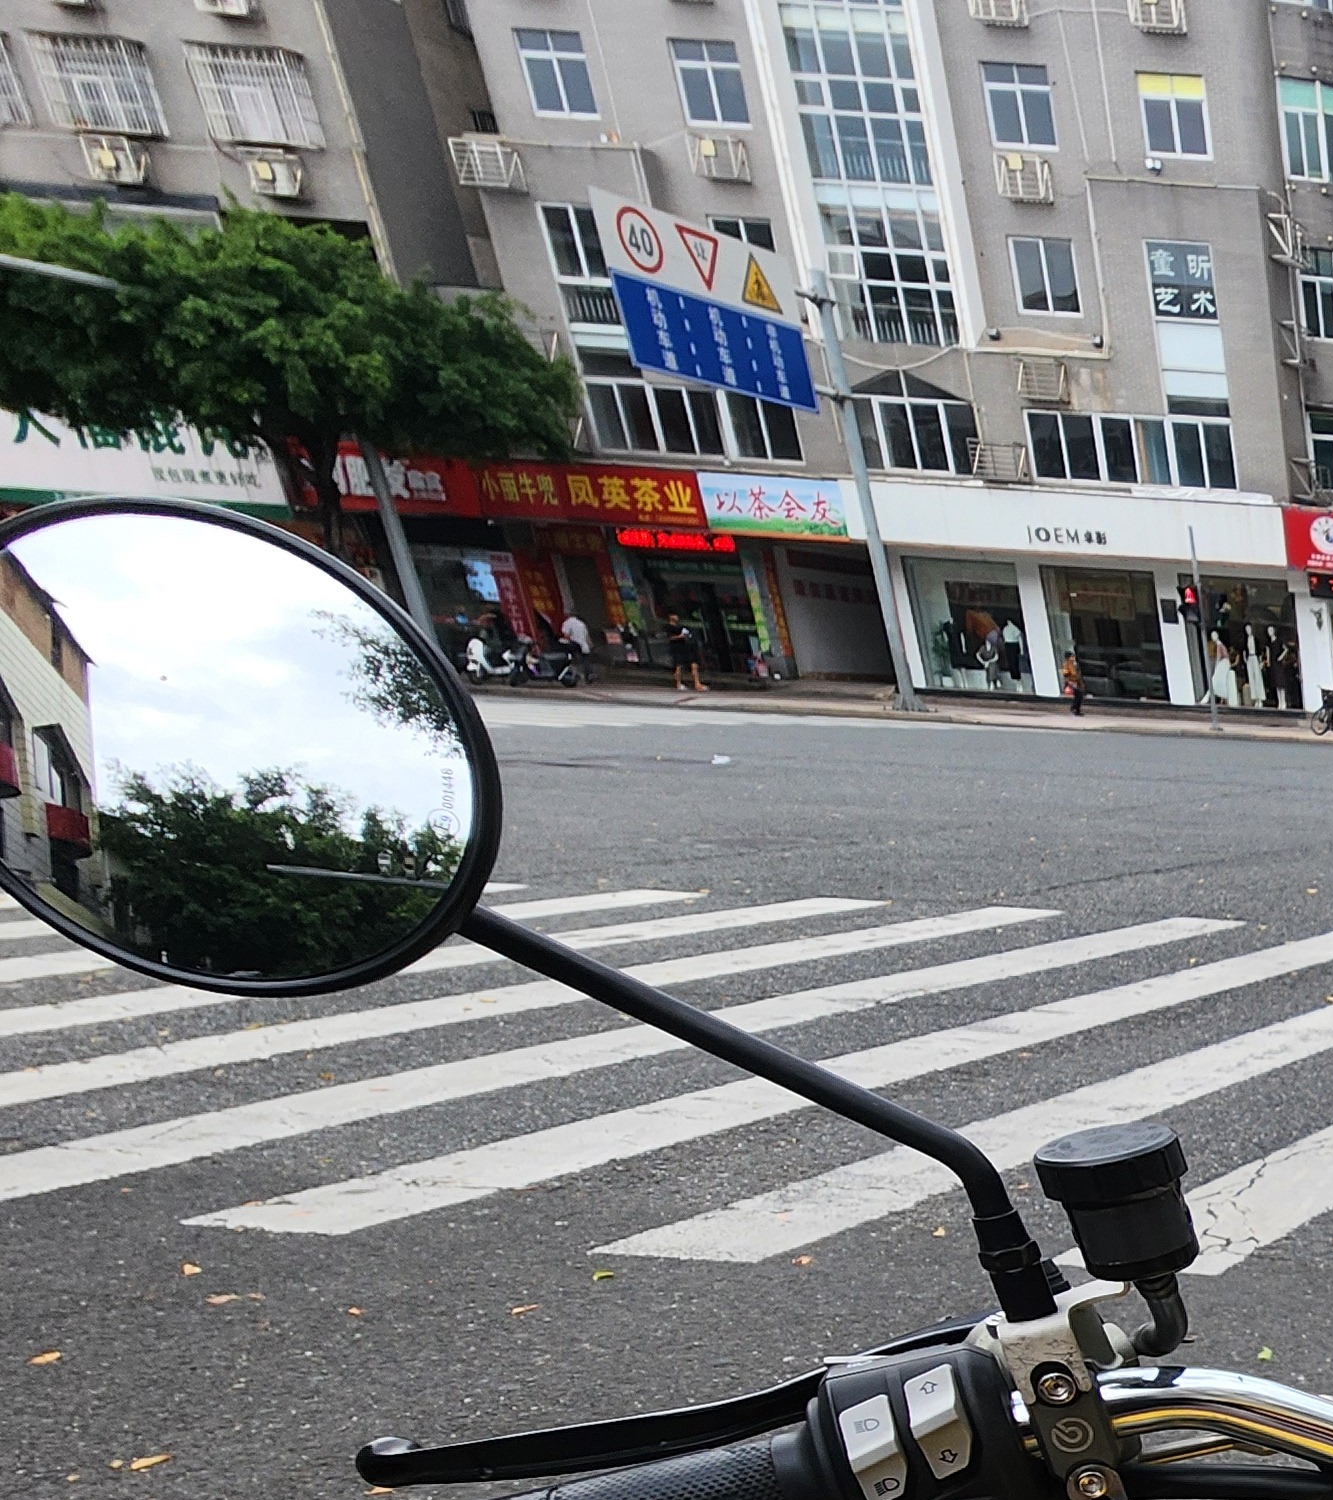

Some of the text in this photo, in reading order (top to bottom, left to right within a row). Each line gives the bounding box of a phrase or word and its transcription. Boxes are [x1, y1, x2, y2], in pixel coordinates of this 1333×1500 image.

[628, 223, 654, 258] 40
[1155, 286, 1216, 314] 艺术
[567, 475, 698, 515] 凤英茶业
